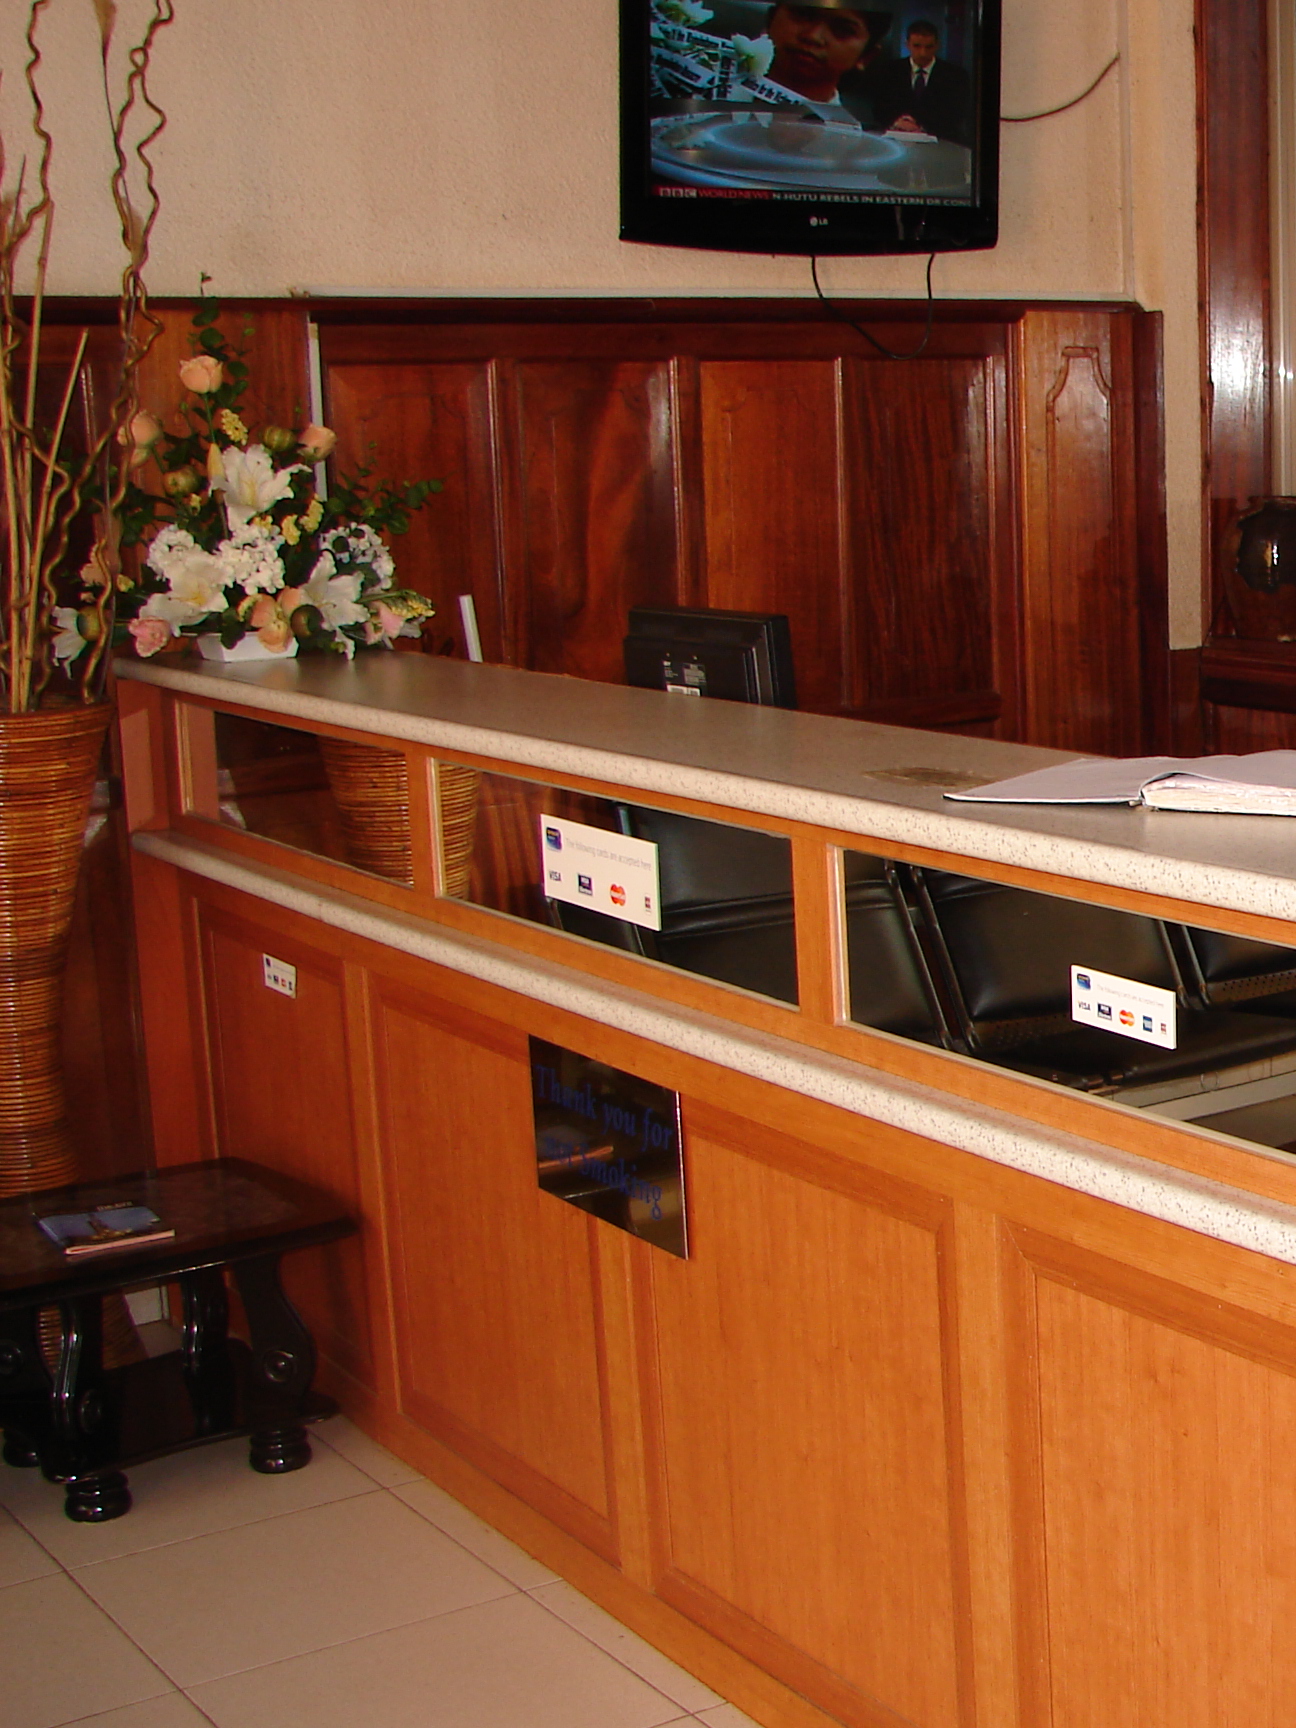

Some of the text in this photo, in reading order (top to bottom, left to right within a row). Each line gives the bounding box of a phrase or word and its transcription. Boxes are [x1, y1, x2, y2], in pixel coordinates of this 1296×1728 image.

[660, 187, 770, 200] BBC WORLD NEWS
[784, 193, 818, 201] HUTU
[820, 194, 859, 203] REBELS
[876, 197, 924, 206] EASTERN
[548, 869, 562, 882] VISA
[1078, 1001, 1091, 1011] VISA
[535, 1064, 674, 1152] Thank you for
